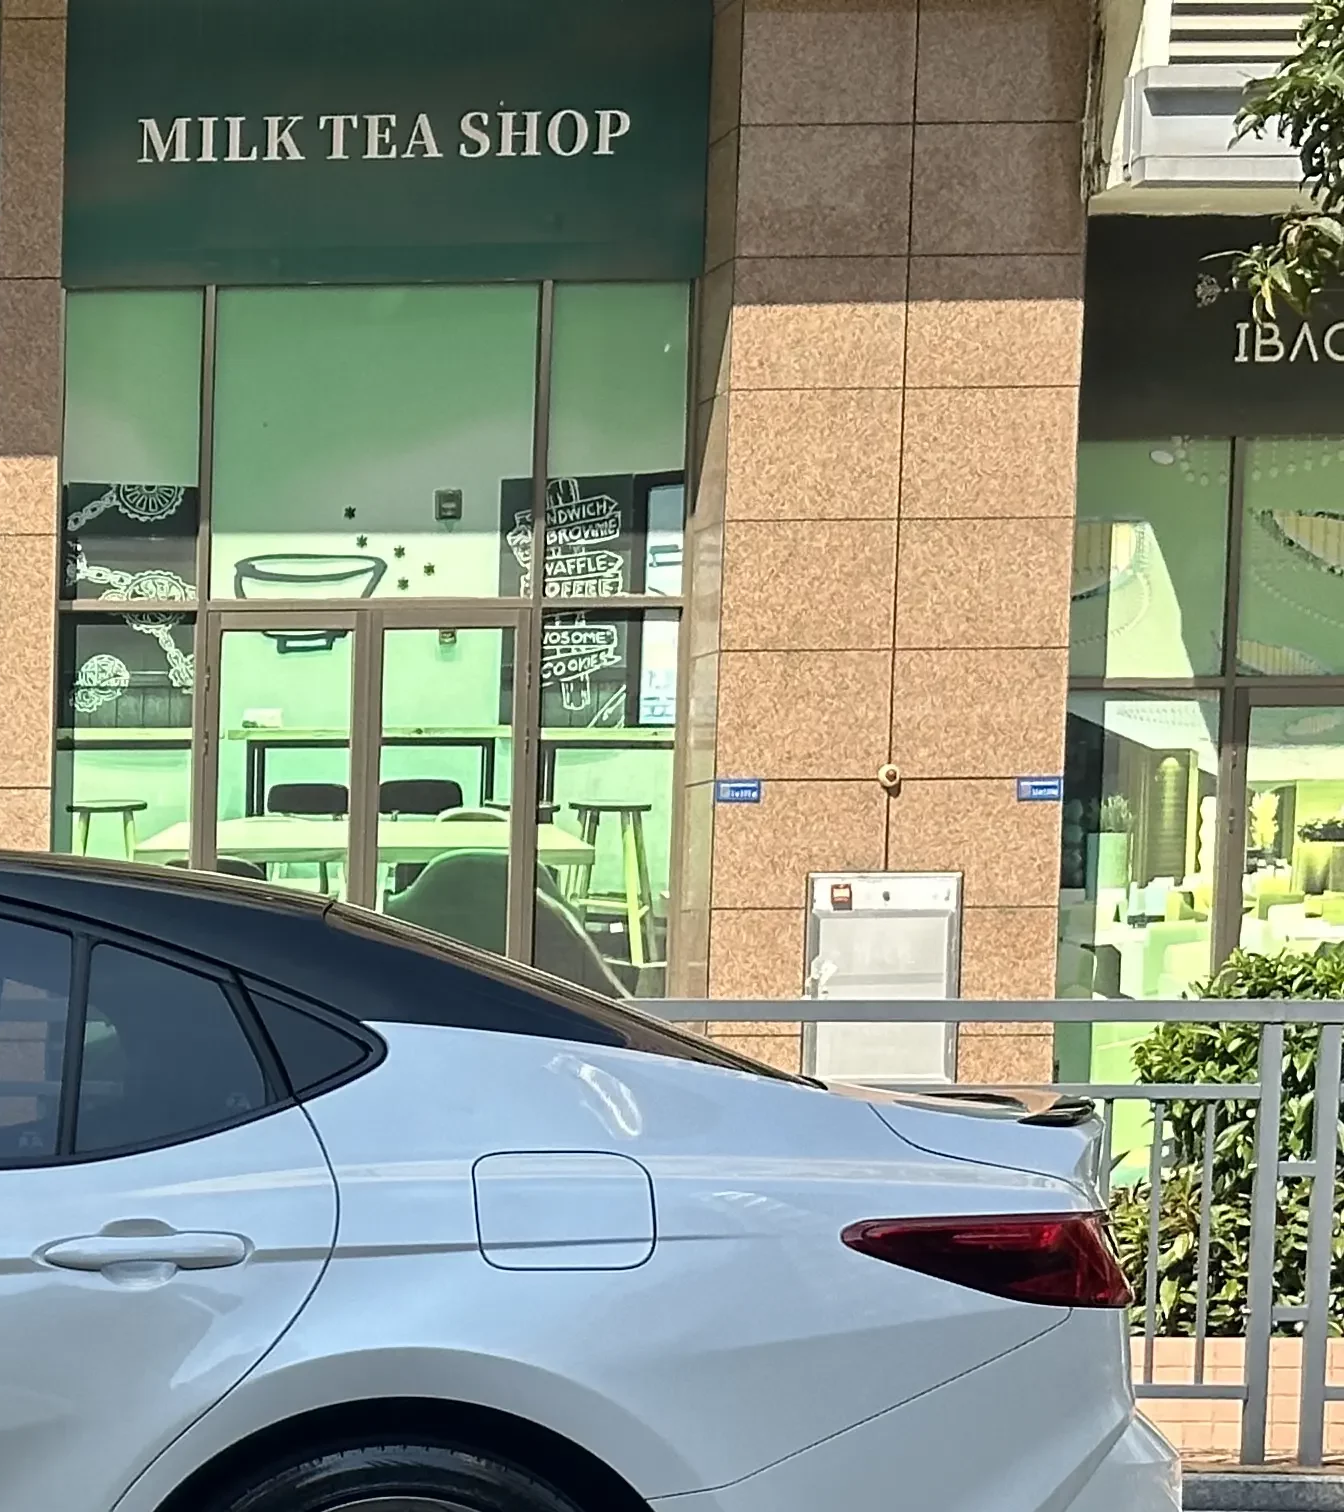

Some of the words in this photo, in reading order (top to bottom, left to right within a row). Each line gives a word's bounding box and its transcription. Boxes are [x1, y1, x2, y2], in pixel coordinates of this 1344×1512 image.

[136, 115, 306, 163] MILK
[318, 112, 444, 160] TEA
[459, 108, 631, 159] SHOP
[545, 579, 616, 598] OFFEE
[543, 629, 606, 646] OSOME
